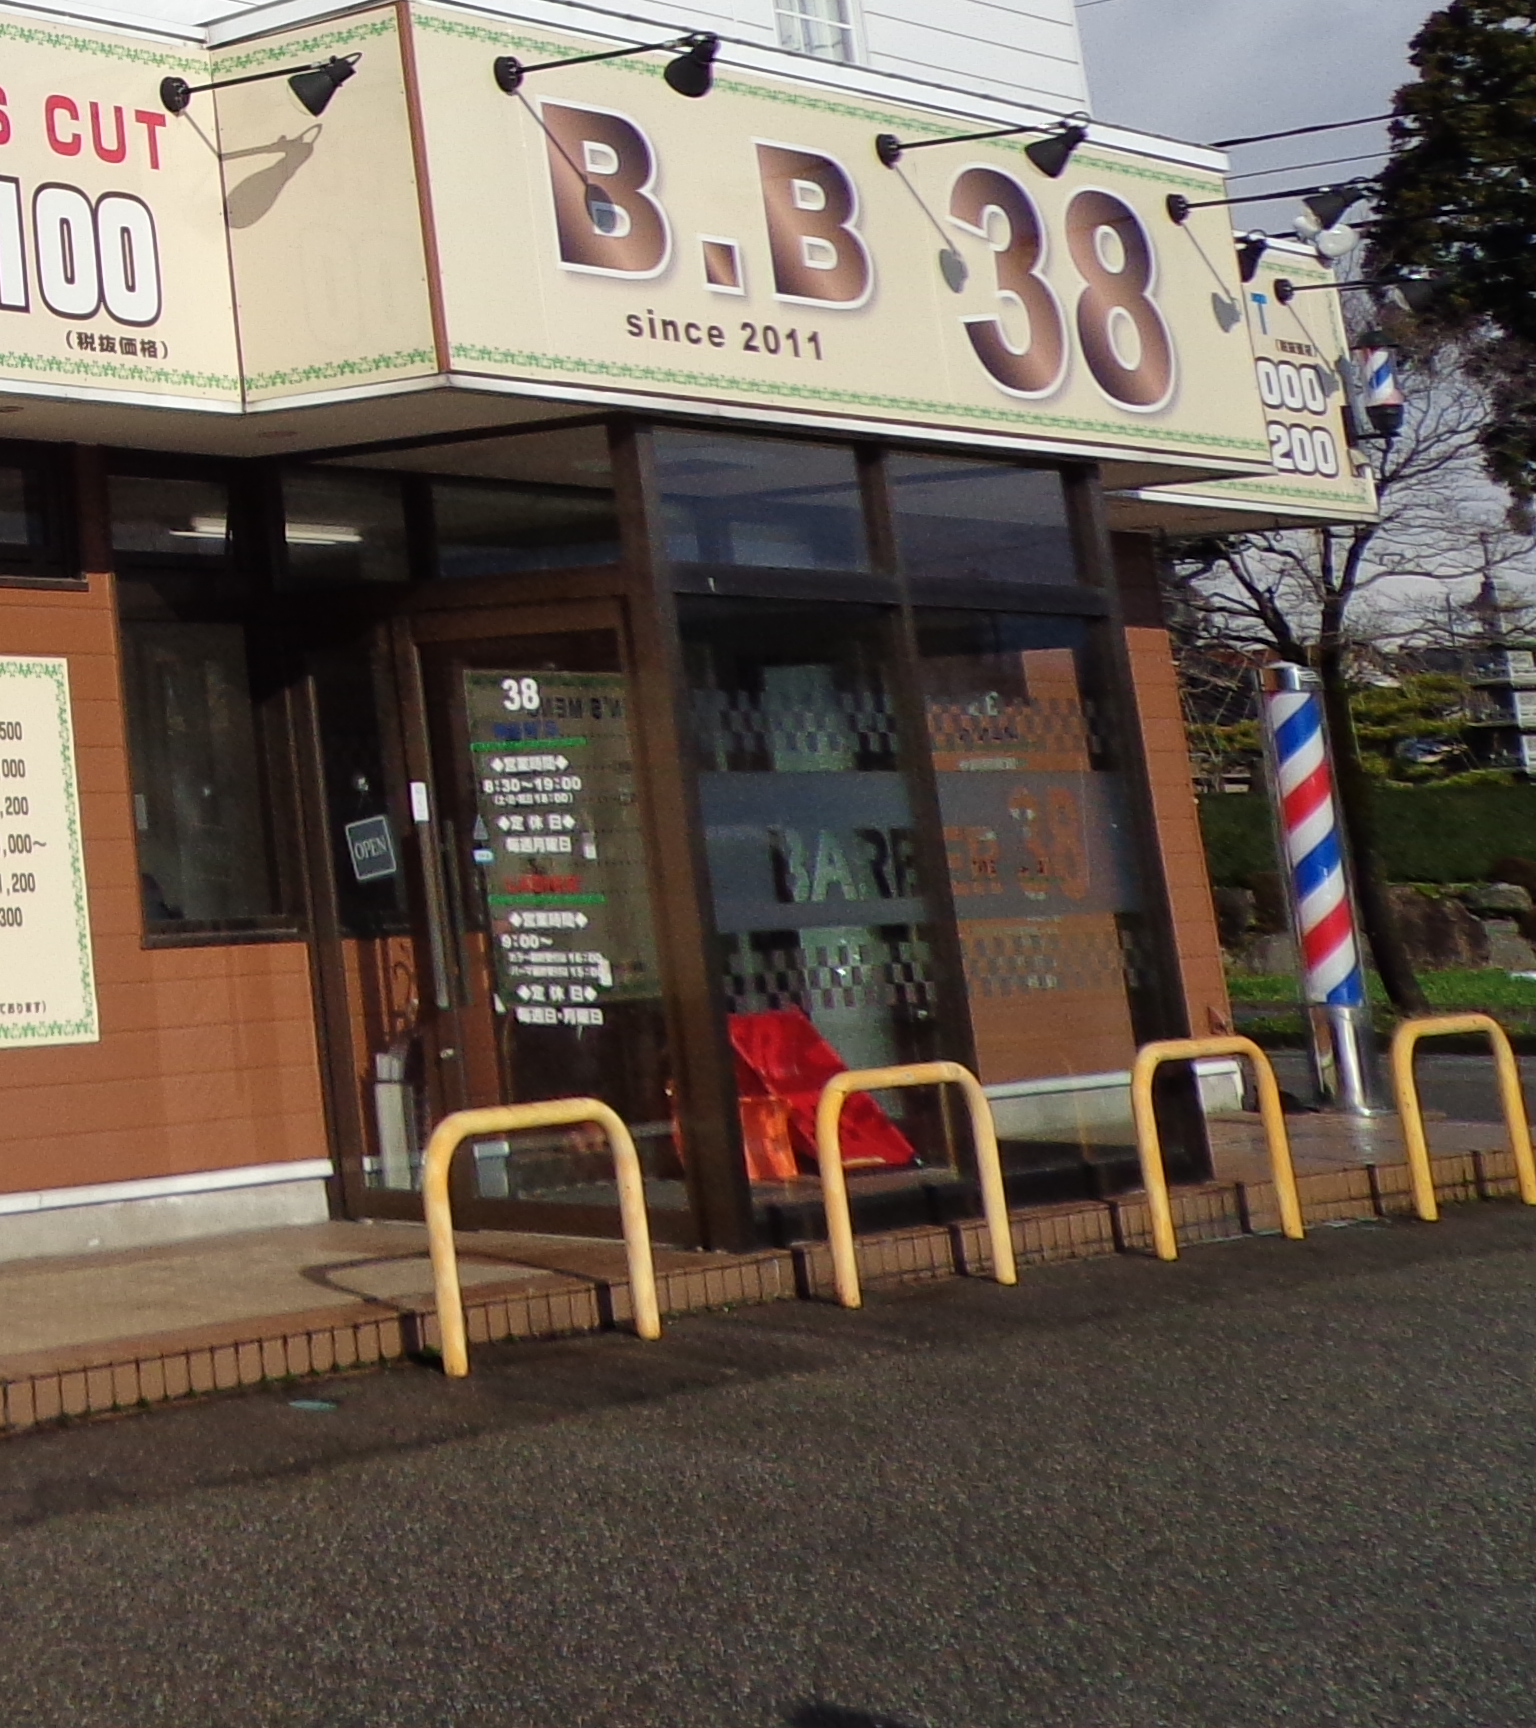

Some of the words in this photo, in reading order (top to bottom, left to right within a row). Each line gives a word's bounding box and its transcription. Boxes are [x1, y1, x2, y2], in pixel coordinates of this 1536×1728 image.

[45, 93, 167, 171] CUT
[943, 160, 1180, 416] 38
[64, 328, 170, 361] (税抜価格)
[625, 308, 727, 349] since
[741, 323, 826, 363] 2011
[501, 677, 541, 711] 38
[353, 835, 389, 861] OPEN
